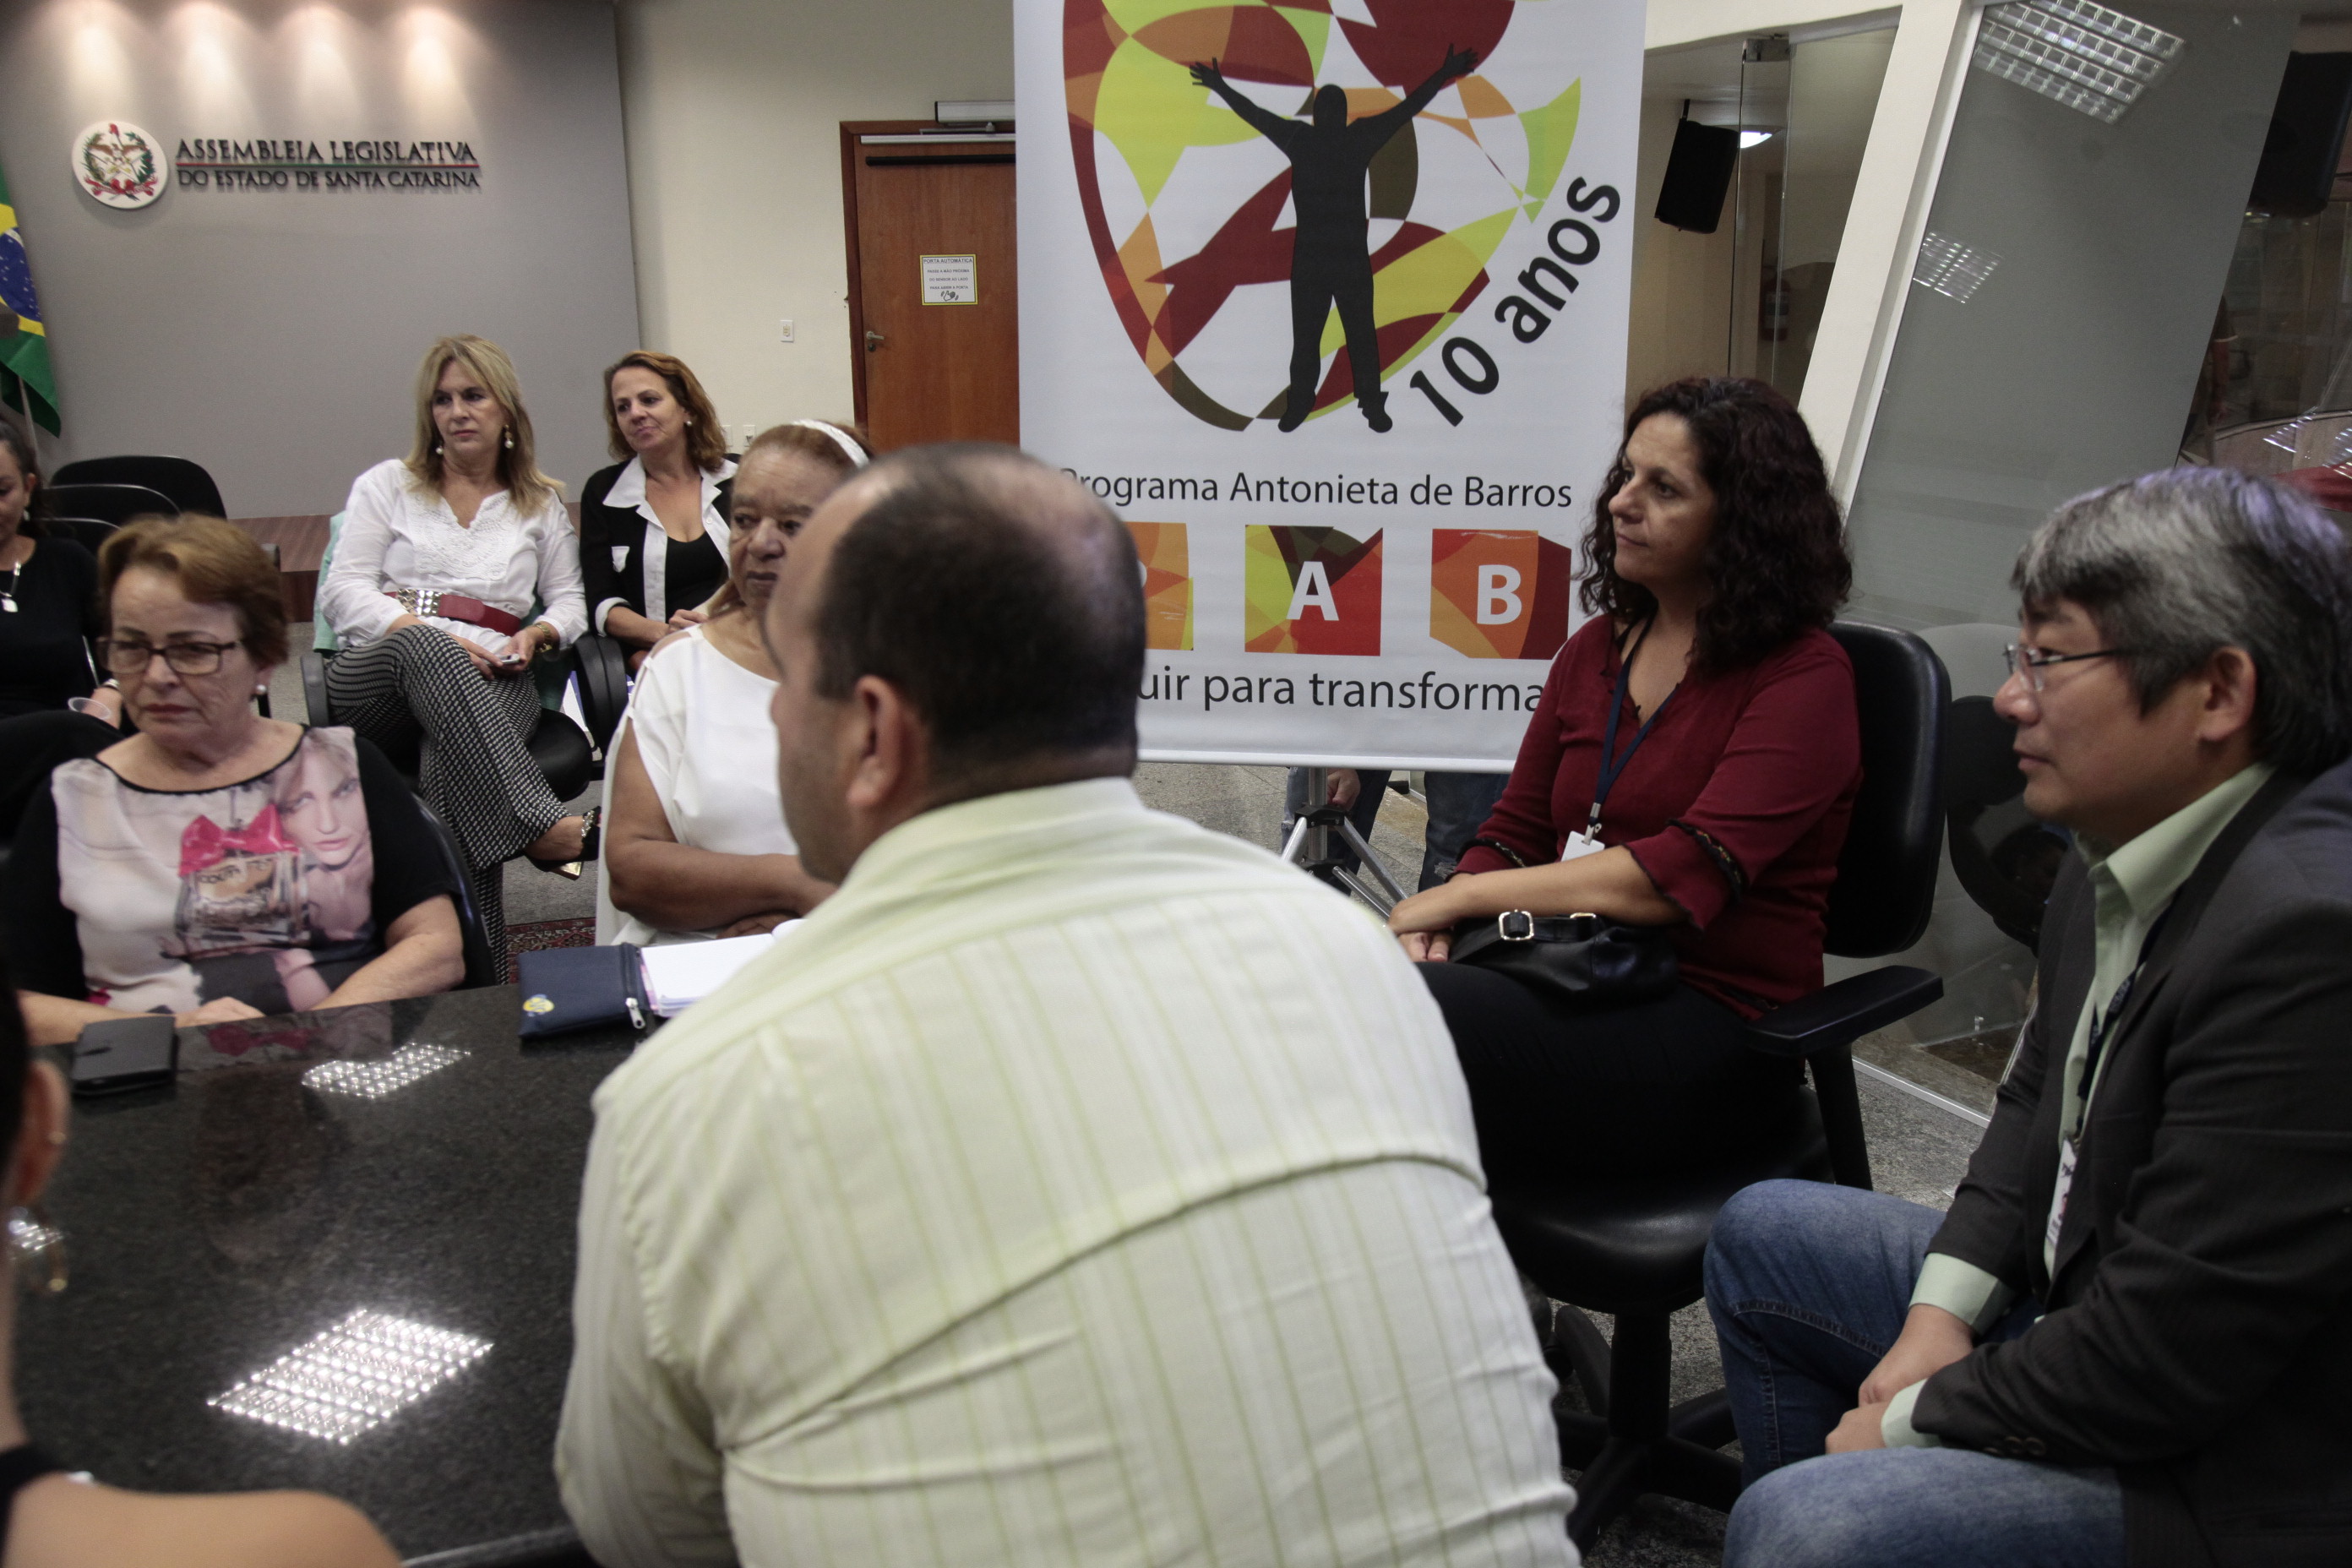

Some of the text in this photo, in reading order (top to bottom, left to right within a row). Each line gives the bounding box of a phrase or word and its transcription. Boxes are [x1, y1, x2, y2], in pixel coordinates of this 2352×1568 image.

[176, 139, 478, 161] ASSEMBLEIA LEGISLATIVA
[177, 169, 480, 188] DO ESTADO DE SANTA CATARINA
[1410, 176, 1620, 427] 10 anos
[1229, 472, 1399, 505] Antonieta
[1409, 474, 1453, 505] de
[1464, 476, 1572, 508] Barros
[1286, 561, 1522, 625] A B
[1204, 675, 1294, 711] para
